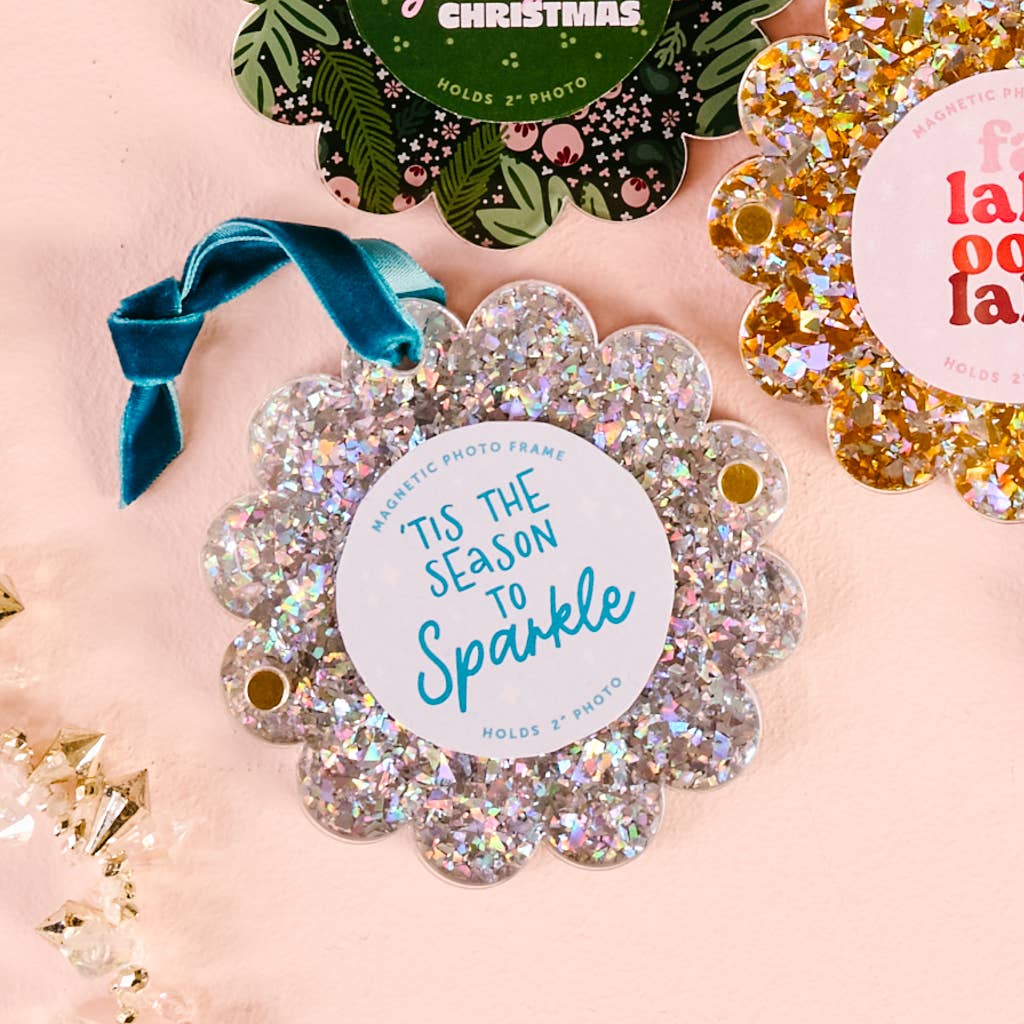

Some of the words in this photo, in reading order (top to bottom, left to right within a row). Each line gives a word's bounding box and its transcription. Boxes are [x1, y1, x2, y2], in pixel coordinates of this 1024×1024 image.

[438, 0, 641, 29] CHRISTMAS
[437, 78, 493, 105] HOLDS
[531, 77, 587, 104] PHOTO
[912, 90, 996, 139] MAGNETIC
[944, 357, 999, 383] HOLDS
[371, 462, 437, 533] MAGNETIC
[443, 442, 501, 466] PHOTO
[509, 441, 566, 461] FRAME
[477, 468, 549, 522] THE
[485, 583, 527, 619] TO
[418, 566, 635, 712] Sparkle
[482, 725, 540, 739] HOLDS
[573, 677, 621, 720] PHOTO
